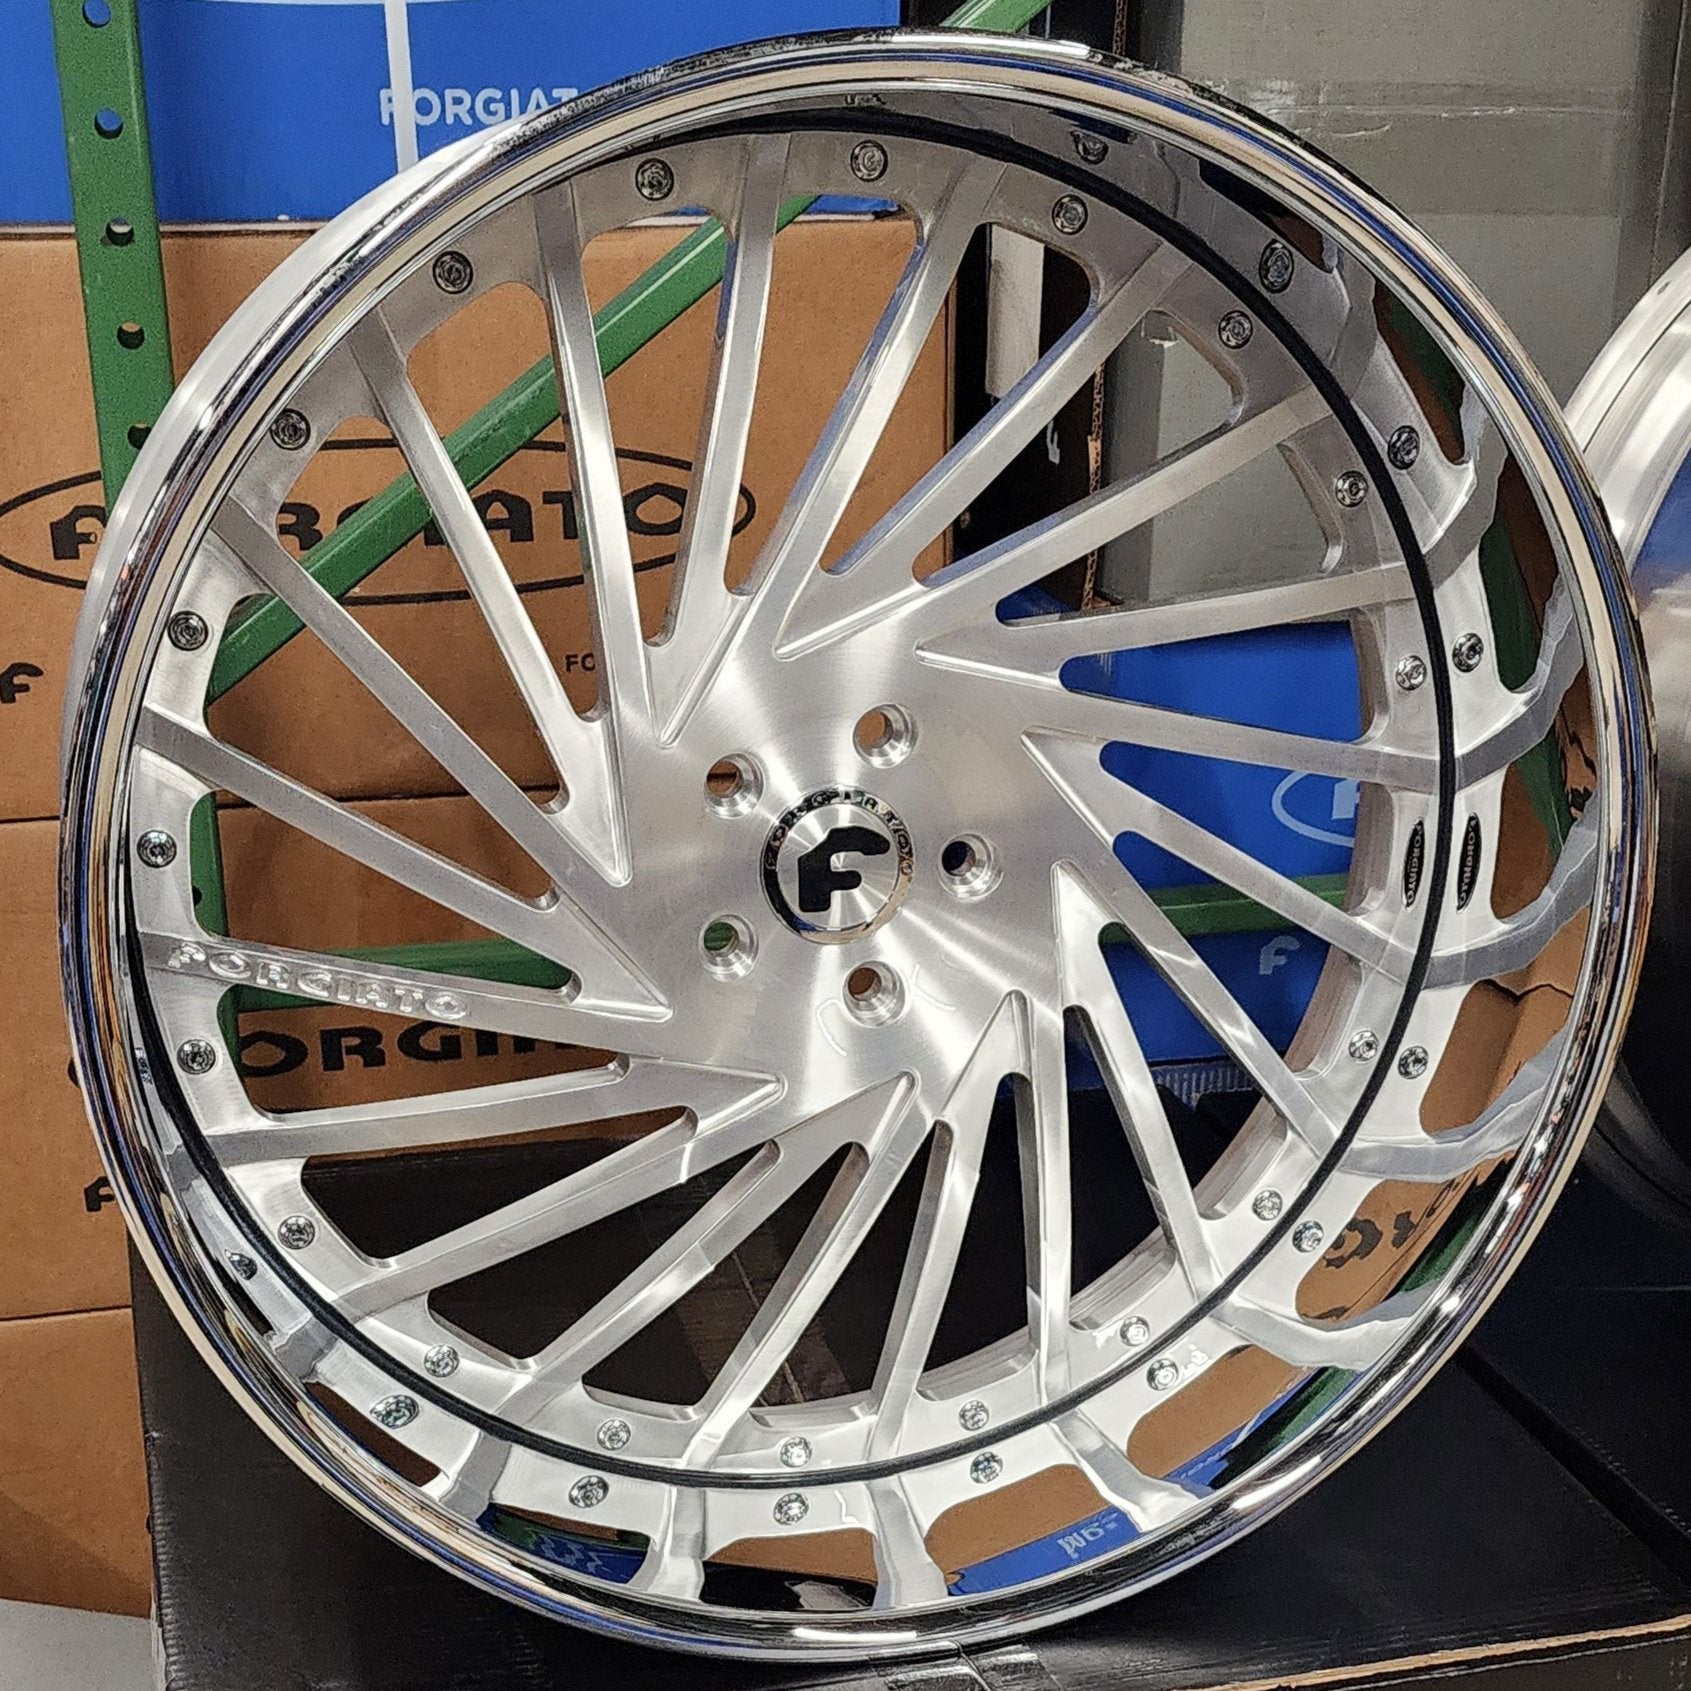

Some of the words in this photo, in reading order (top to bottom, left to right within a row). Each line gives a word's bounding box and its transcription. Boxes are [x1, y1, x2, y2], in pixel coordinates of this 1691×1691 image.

[798, 825, 891, 913] F
[168, 942, 467, 1020] FORGIATO
[1259, 935, 1300, 975] F
